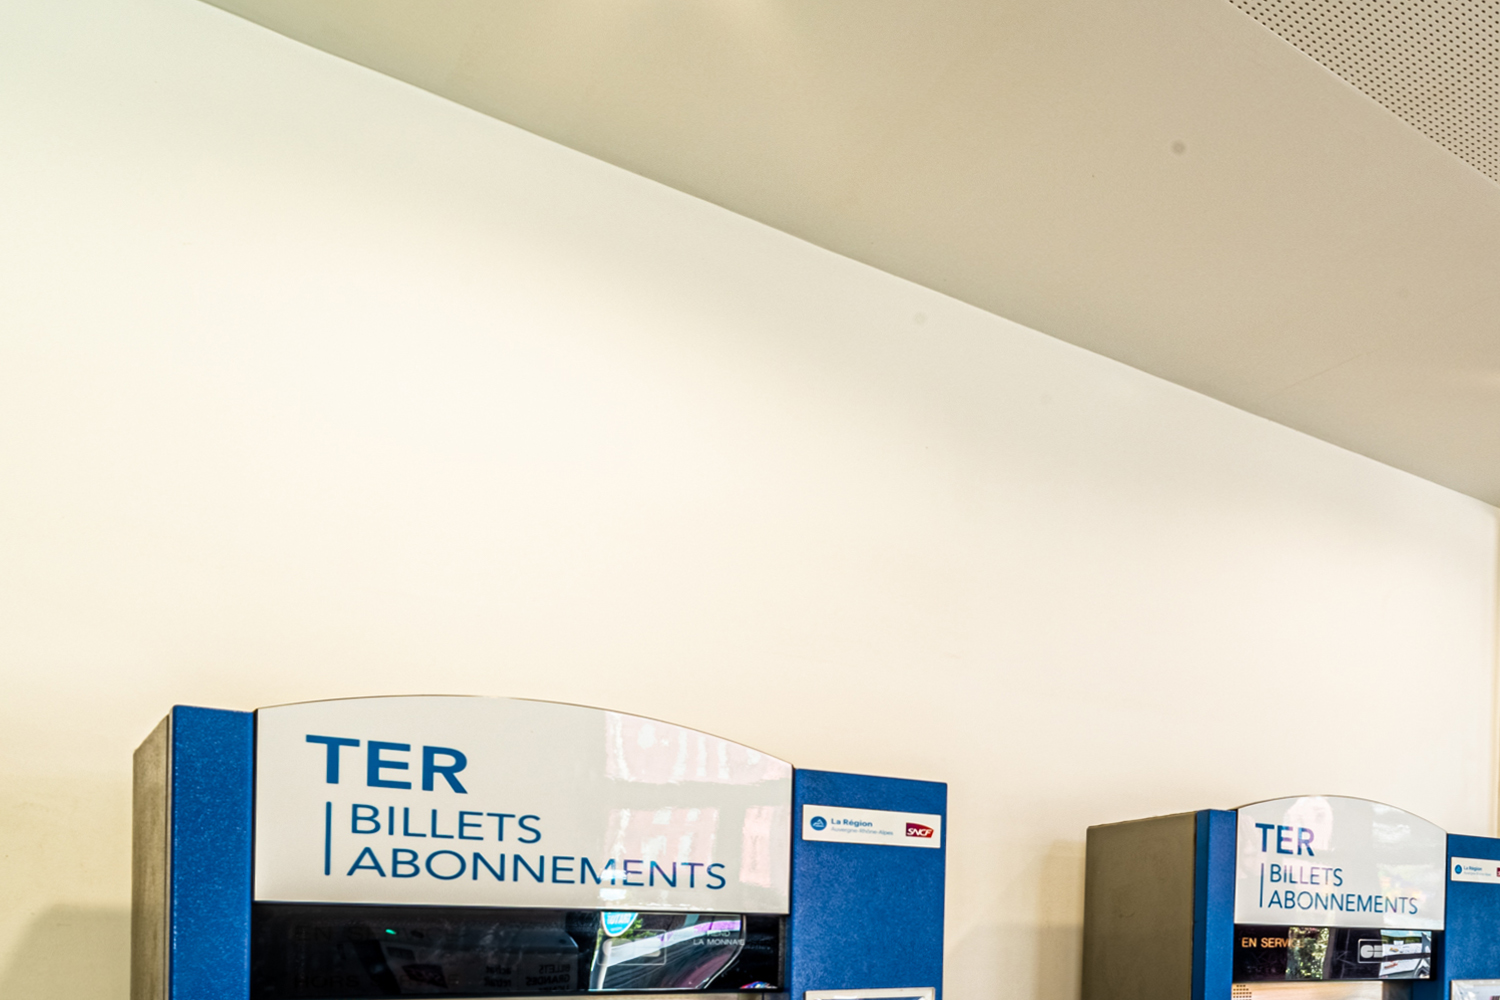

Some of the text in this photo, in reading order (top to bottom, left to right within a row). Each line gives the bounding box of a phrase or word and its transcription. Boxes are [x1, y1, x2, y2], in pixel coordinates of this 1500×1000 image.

[306, 734, 468, 794] TER
[350, 803, 542, 844] BILLETS
[906, 828, 932, 837] SNCF
[1255, 823, 1315, 856] TER
[346, 846, 726, 890] ABONNEMENTS
[1270, 863, 1343, 886] BILLETS
[1268, 890, 1418, 915] ABONNEMENTS
[1242, 937, 1257, 948] EN
